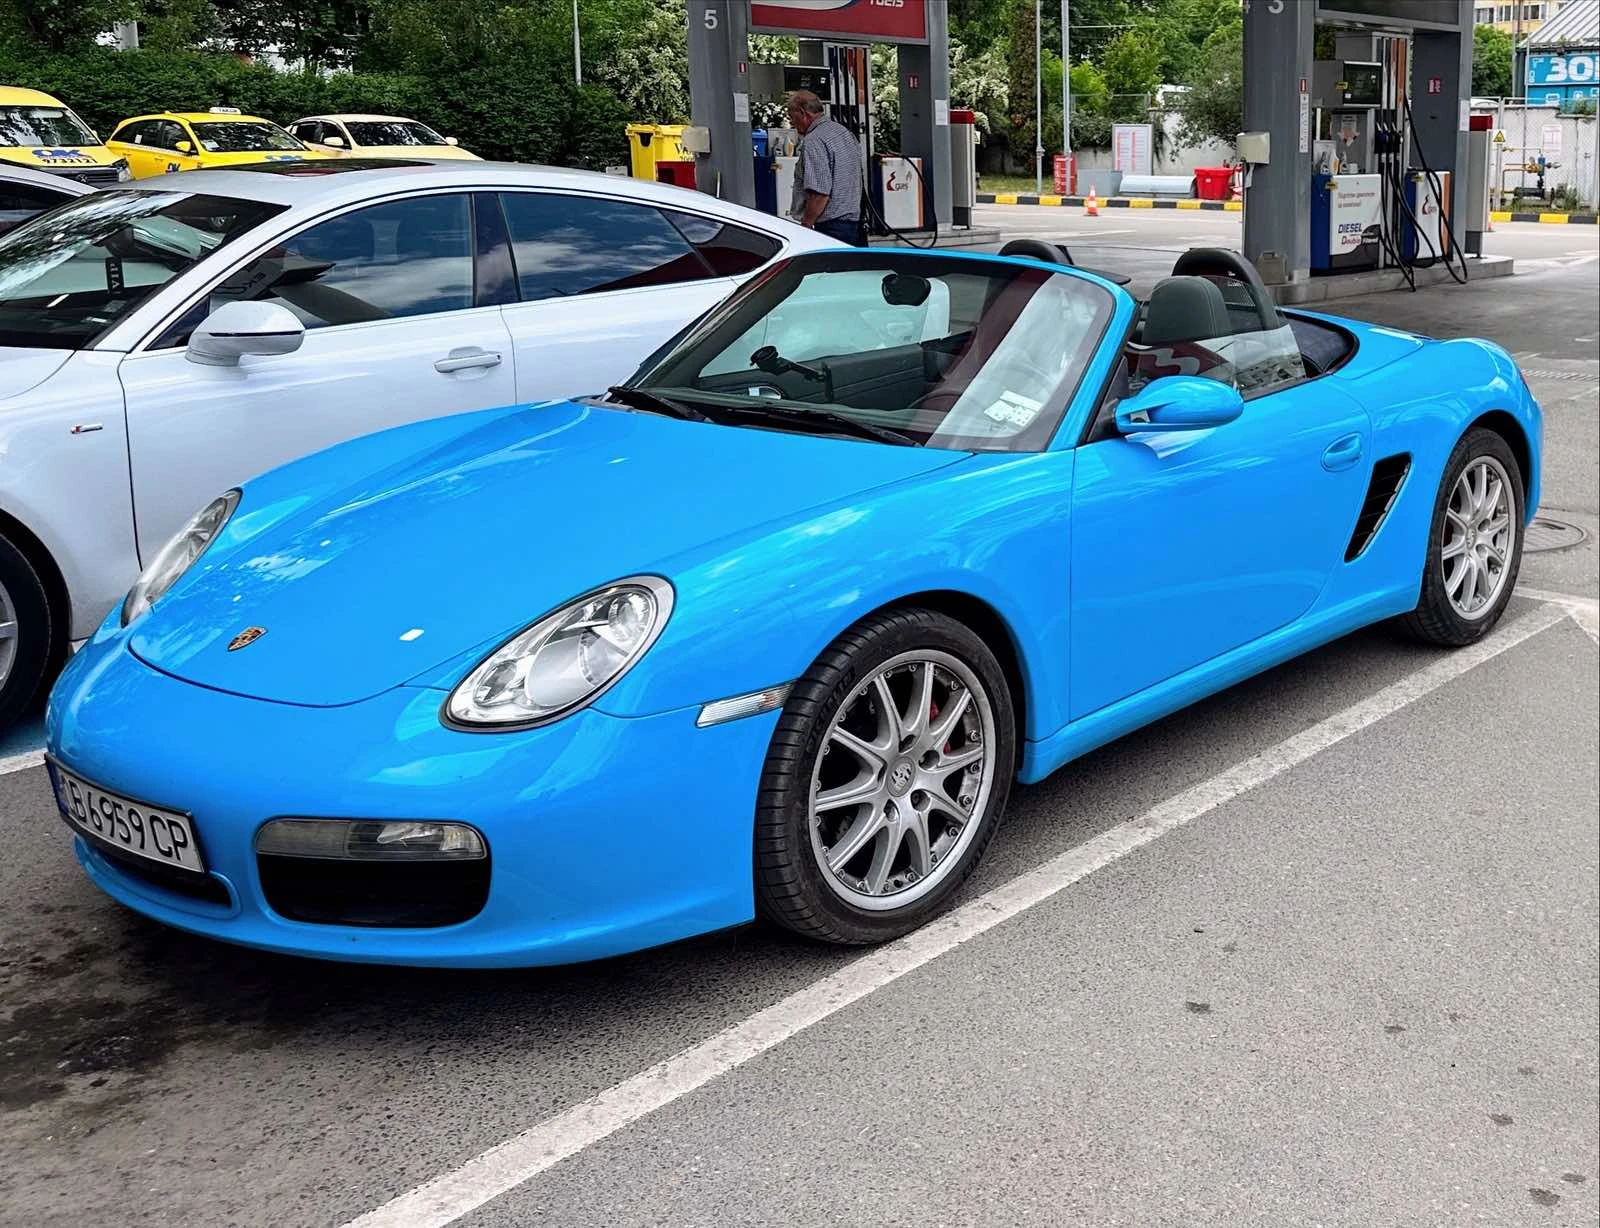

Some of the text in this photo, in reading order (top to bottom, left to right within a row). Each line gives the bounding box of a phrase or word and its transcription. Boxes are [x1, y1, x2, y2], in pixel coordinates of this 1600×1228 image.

[704, 9, 719, 30] 5
[1338, 223, 1362, 234] DIESEL
[87, 791, 145, 850] 6959
[149, 814, 189, 861] CP
